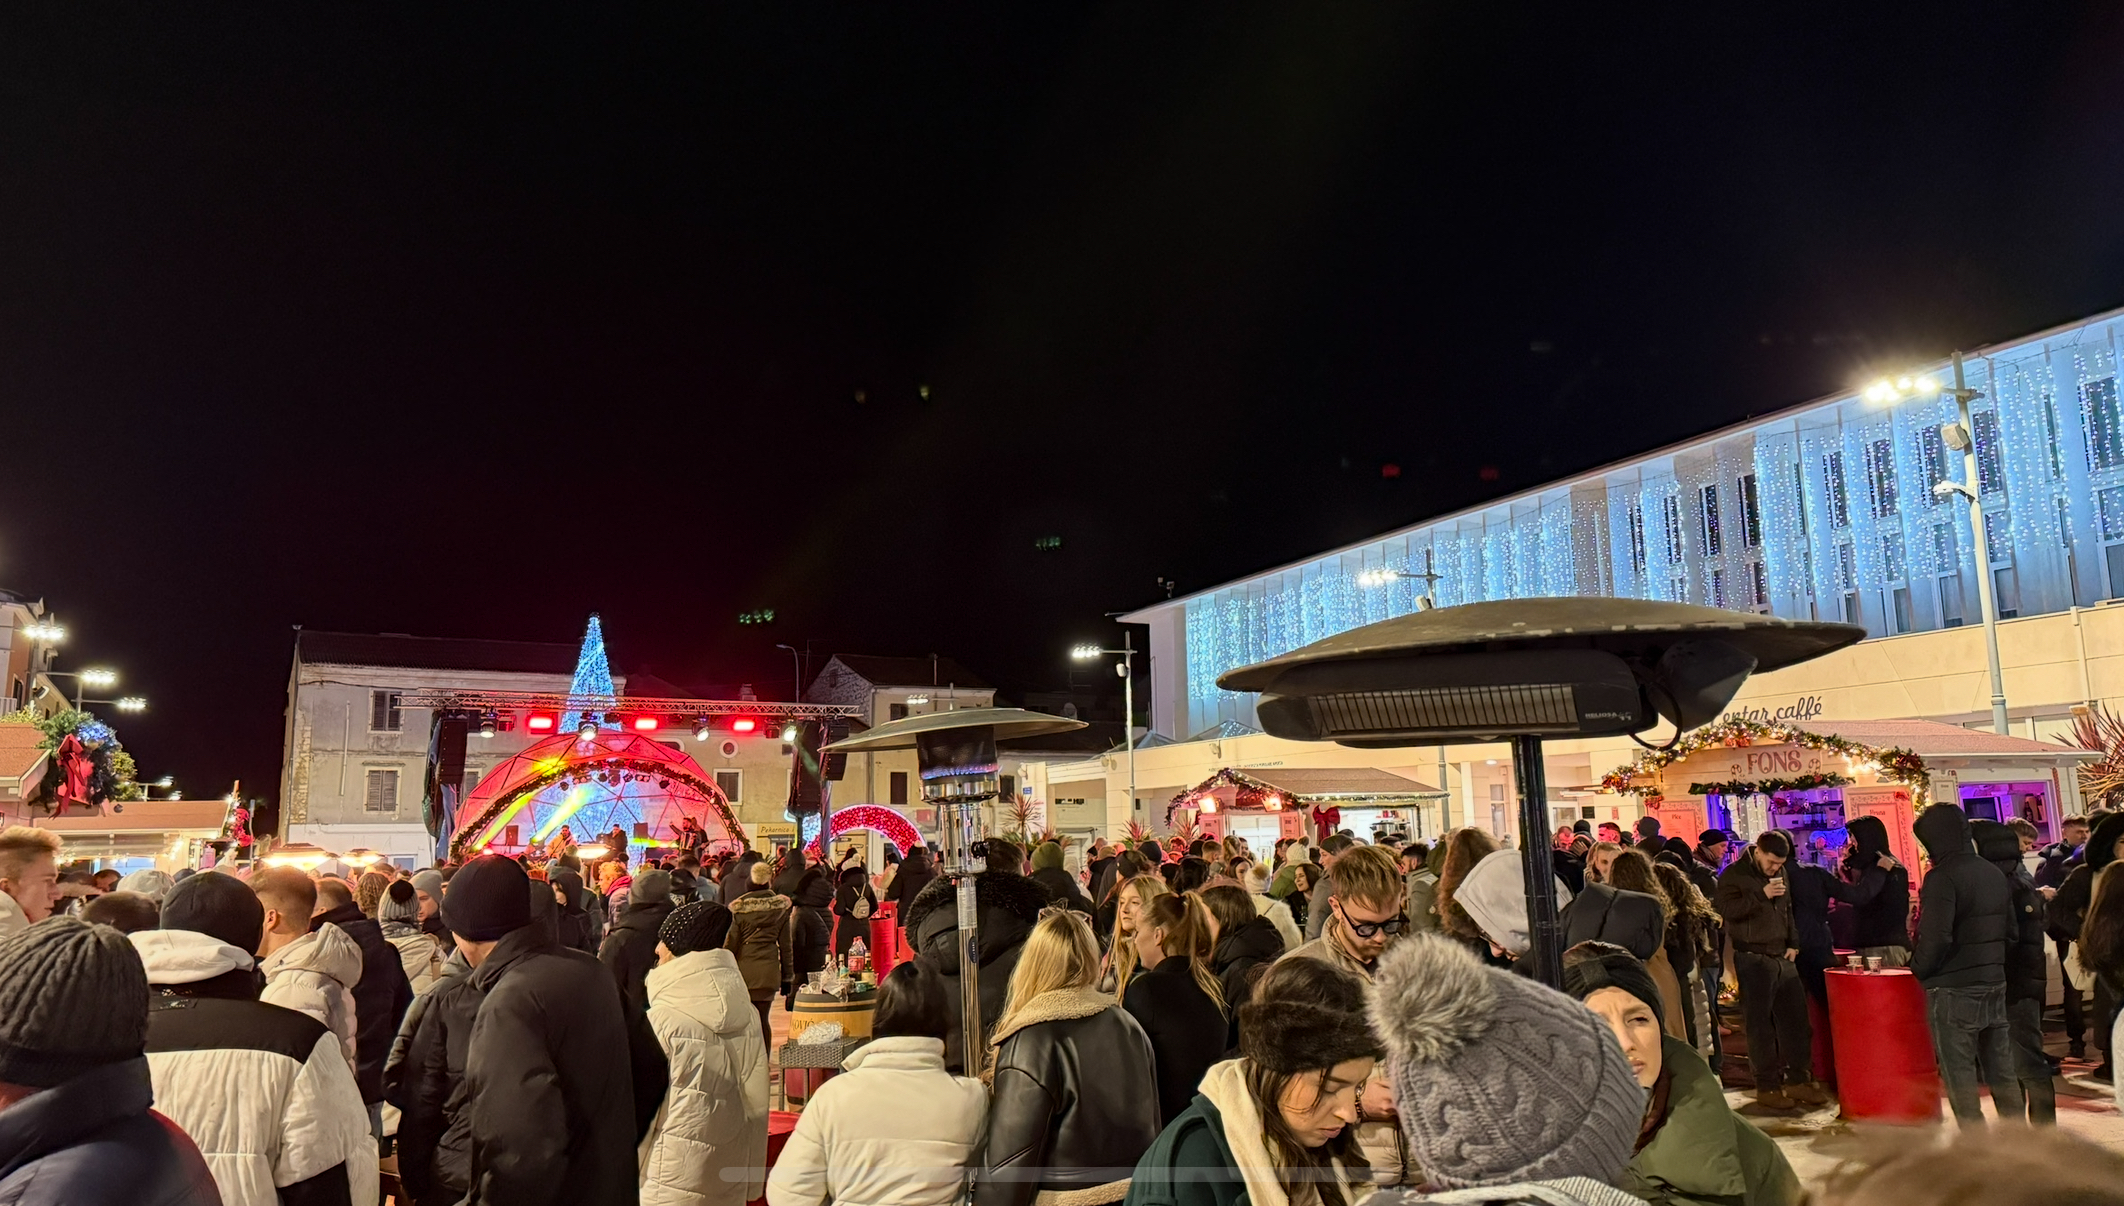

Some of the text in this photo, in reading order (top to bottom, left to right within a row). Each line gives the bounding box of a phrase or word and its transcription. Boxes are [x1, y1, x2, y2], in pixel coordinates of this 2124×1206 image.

[1585, 711, 1618, 719] HELIOSA
[1711, 695, 1822, 726] entar caffé
[1746, 749, 1802, 775] FONS
